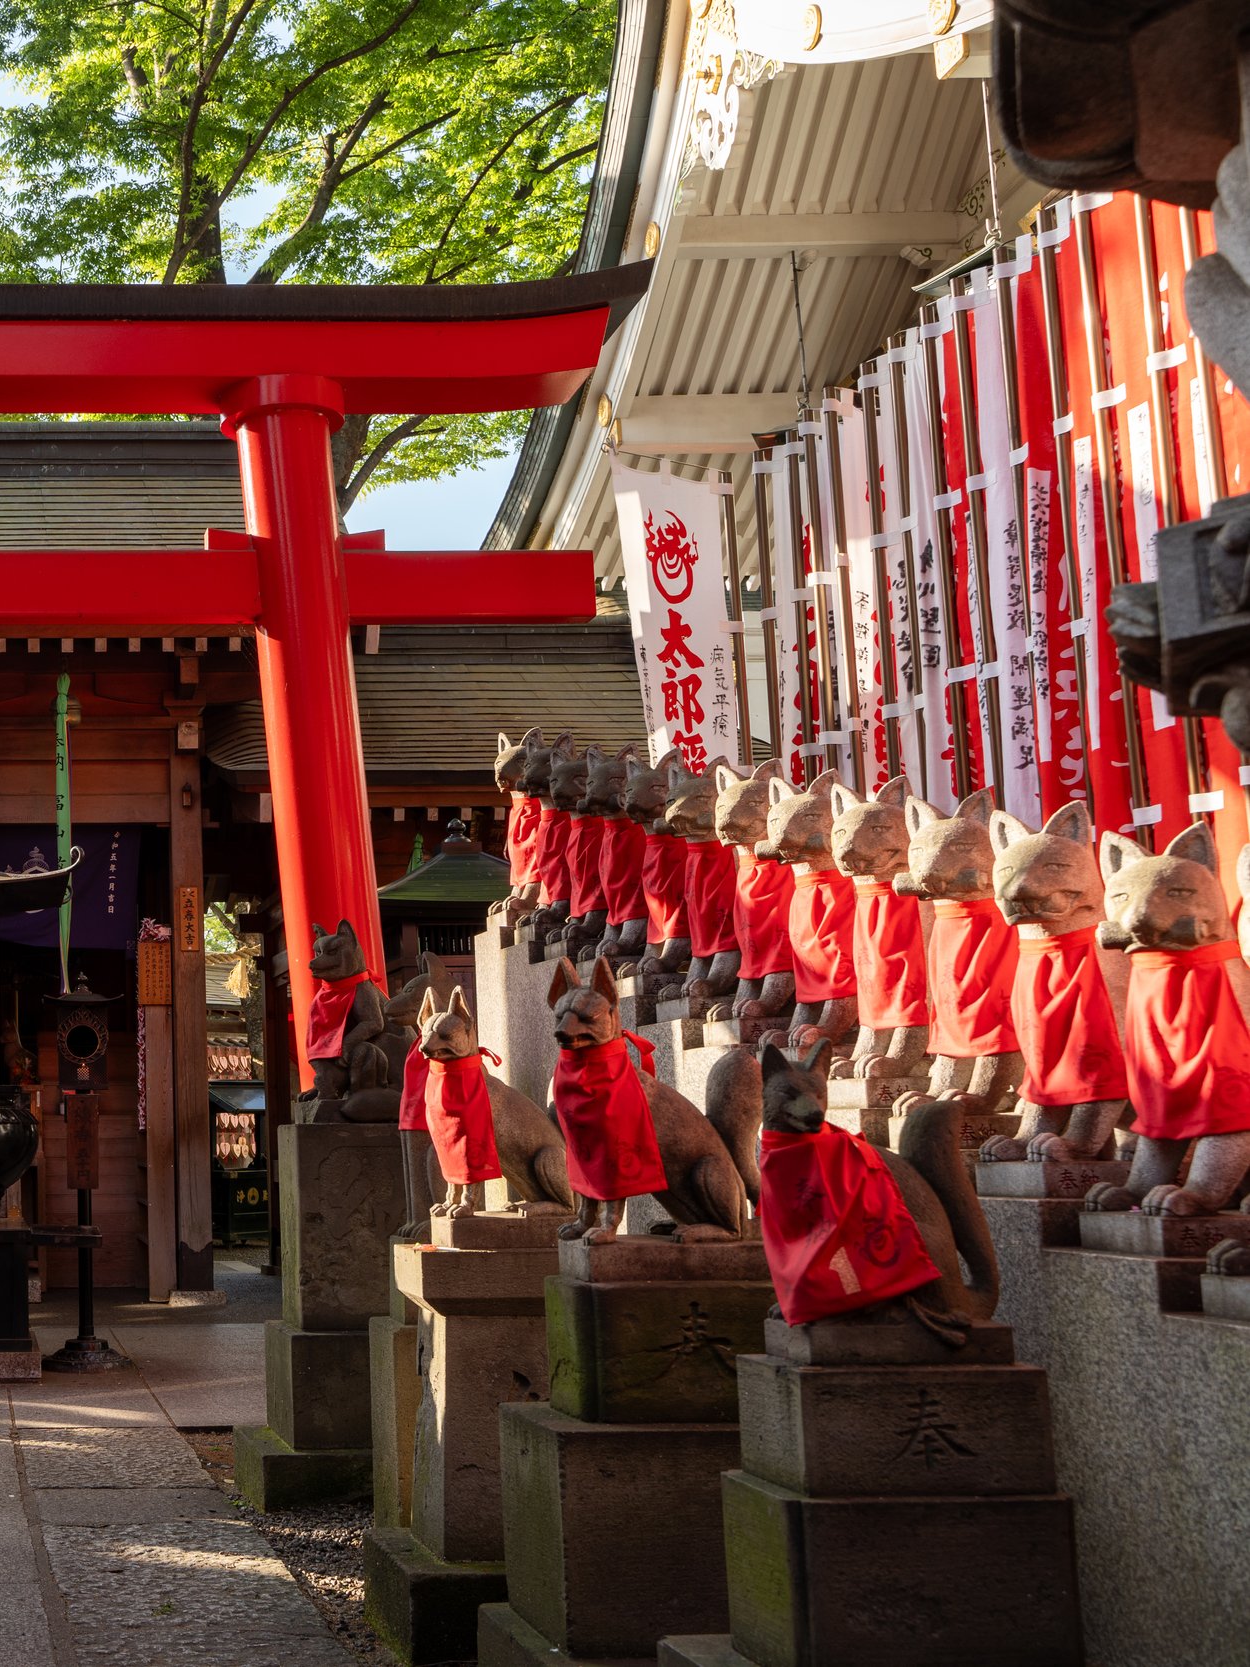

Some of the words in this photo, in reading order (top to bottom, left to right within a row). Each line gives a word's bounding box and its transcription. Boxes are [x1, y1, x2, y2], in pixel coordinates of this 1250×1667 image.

[710, 645, 731, 738] 病気平癒
[184, 898, 195, 945] 立春大吉
[1060, 1169, 1101, 1191] 奉納
[1180, 1226, 1224, 1251] 奉納
[889, 1388, 975, 1470] 奉
